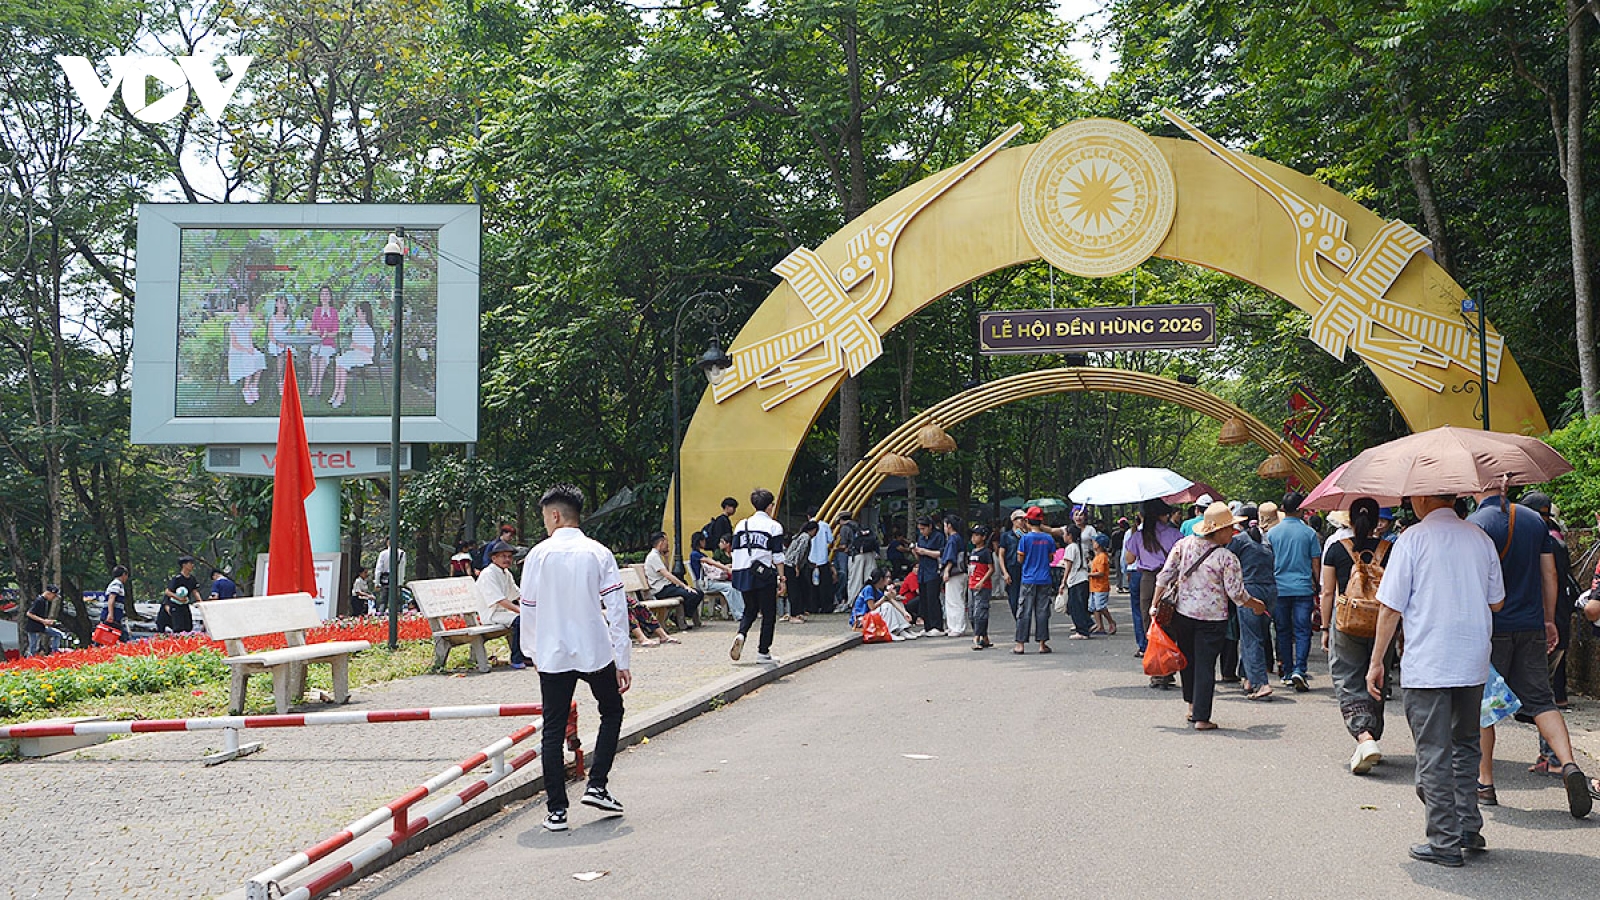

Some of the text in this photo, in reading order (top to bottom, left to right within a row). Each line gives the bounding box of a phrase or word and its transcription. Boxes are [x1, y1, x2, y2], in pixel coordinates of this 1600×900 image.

[991, 316, 1203, 341] LỄ HỘI ĐỀN HÙNG 2026
[260, 450, 356, 469] vtel
